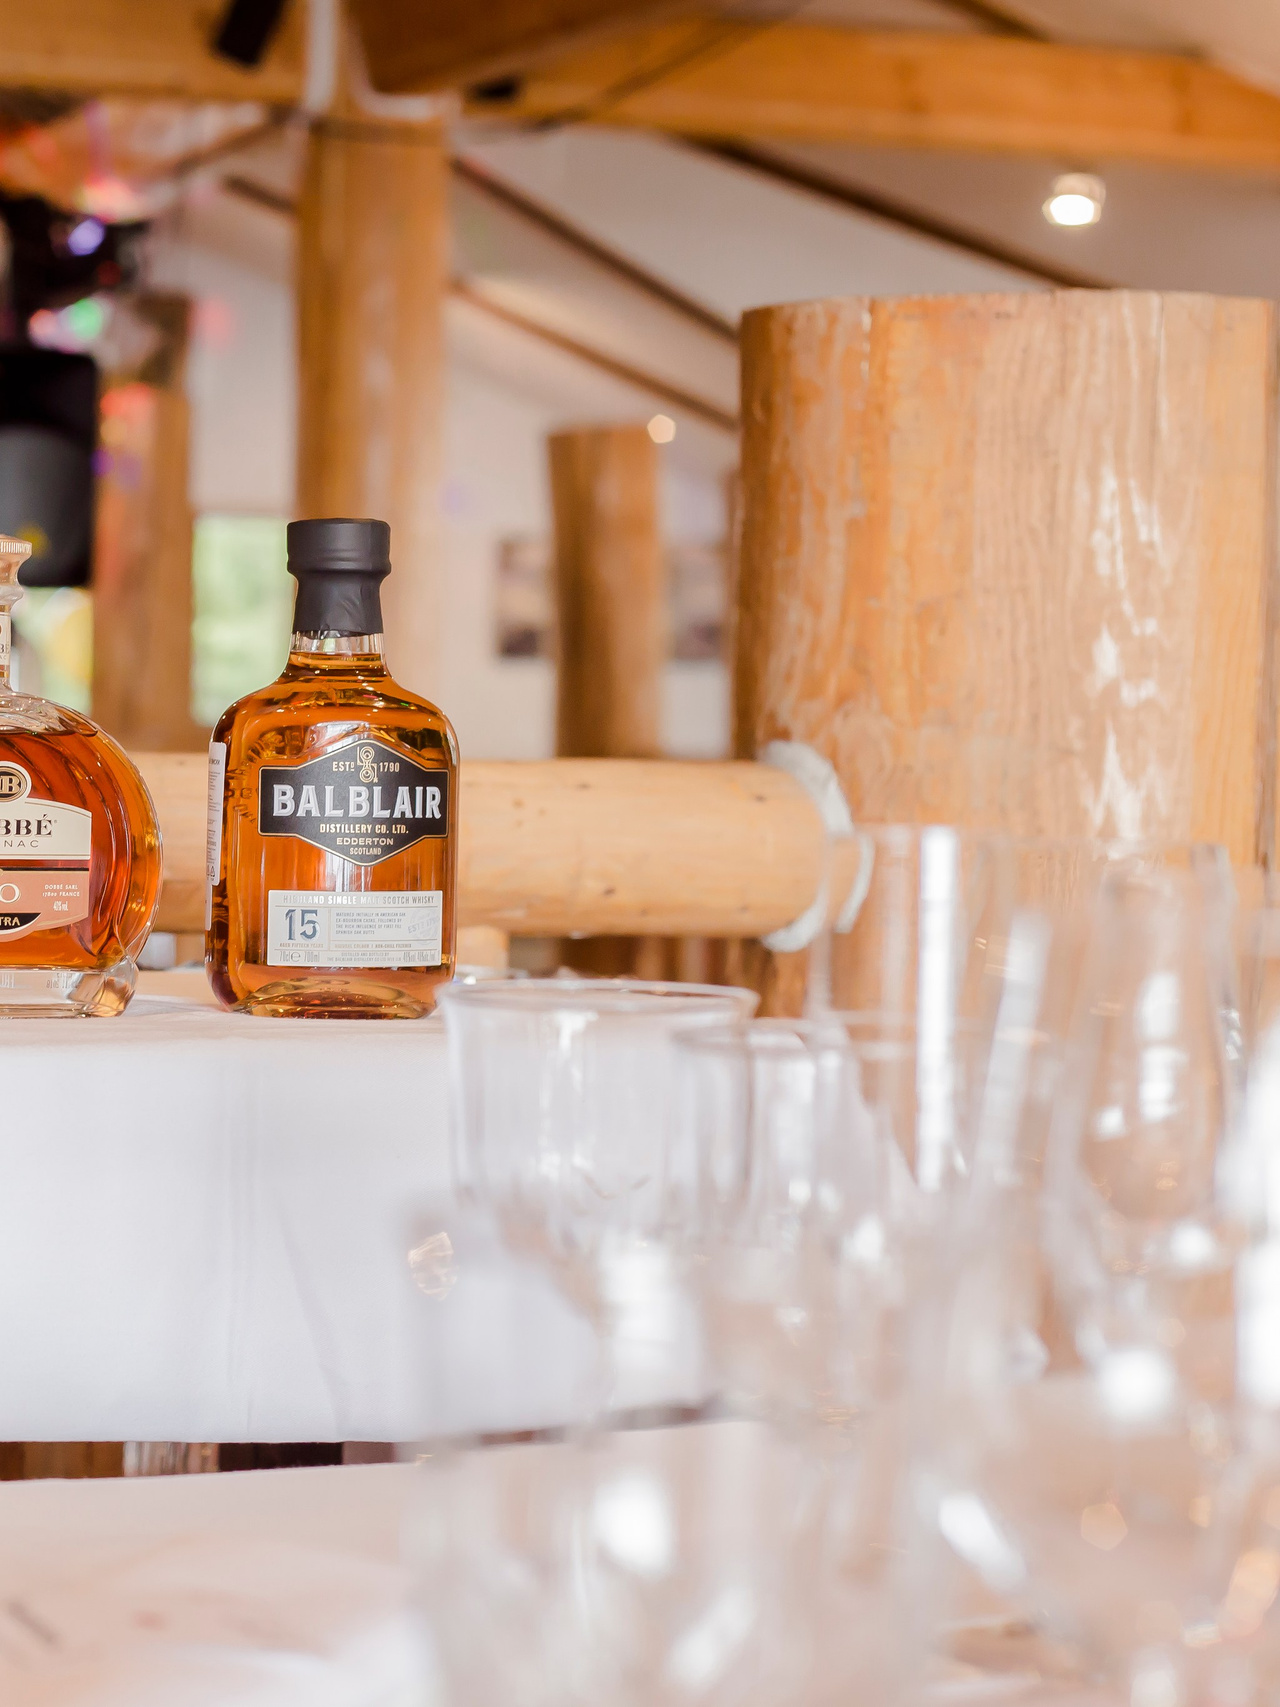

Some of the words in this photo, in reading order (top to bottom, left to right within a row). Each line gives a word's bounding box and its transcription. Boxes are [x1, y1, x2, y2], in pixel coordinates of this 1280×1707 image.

[379, 762, 400, 772] 1790
[272, 784, 442, 820] BALBLAIR
[320, 824, 372, 833] DISTILLERY
[375, 824, 389, 834] CO.
[392, 824, 409, 834] LTD.
[336, 837, 394, 845] EDDERTON
[349, 847, 382, 855] SCOTLAND
[327, 895, 358, 905] SINGLE
[382, 896, 410, 905] SCOTCH
[412, 895, 435, 904] WHISKY
[285, 909, 321, 941] 15
